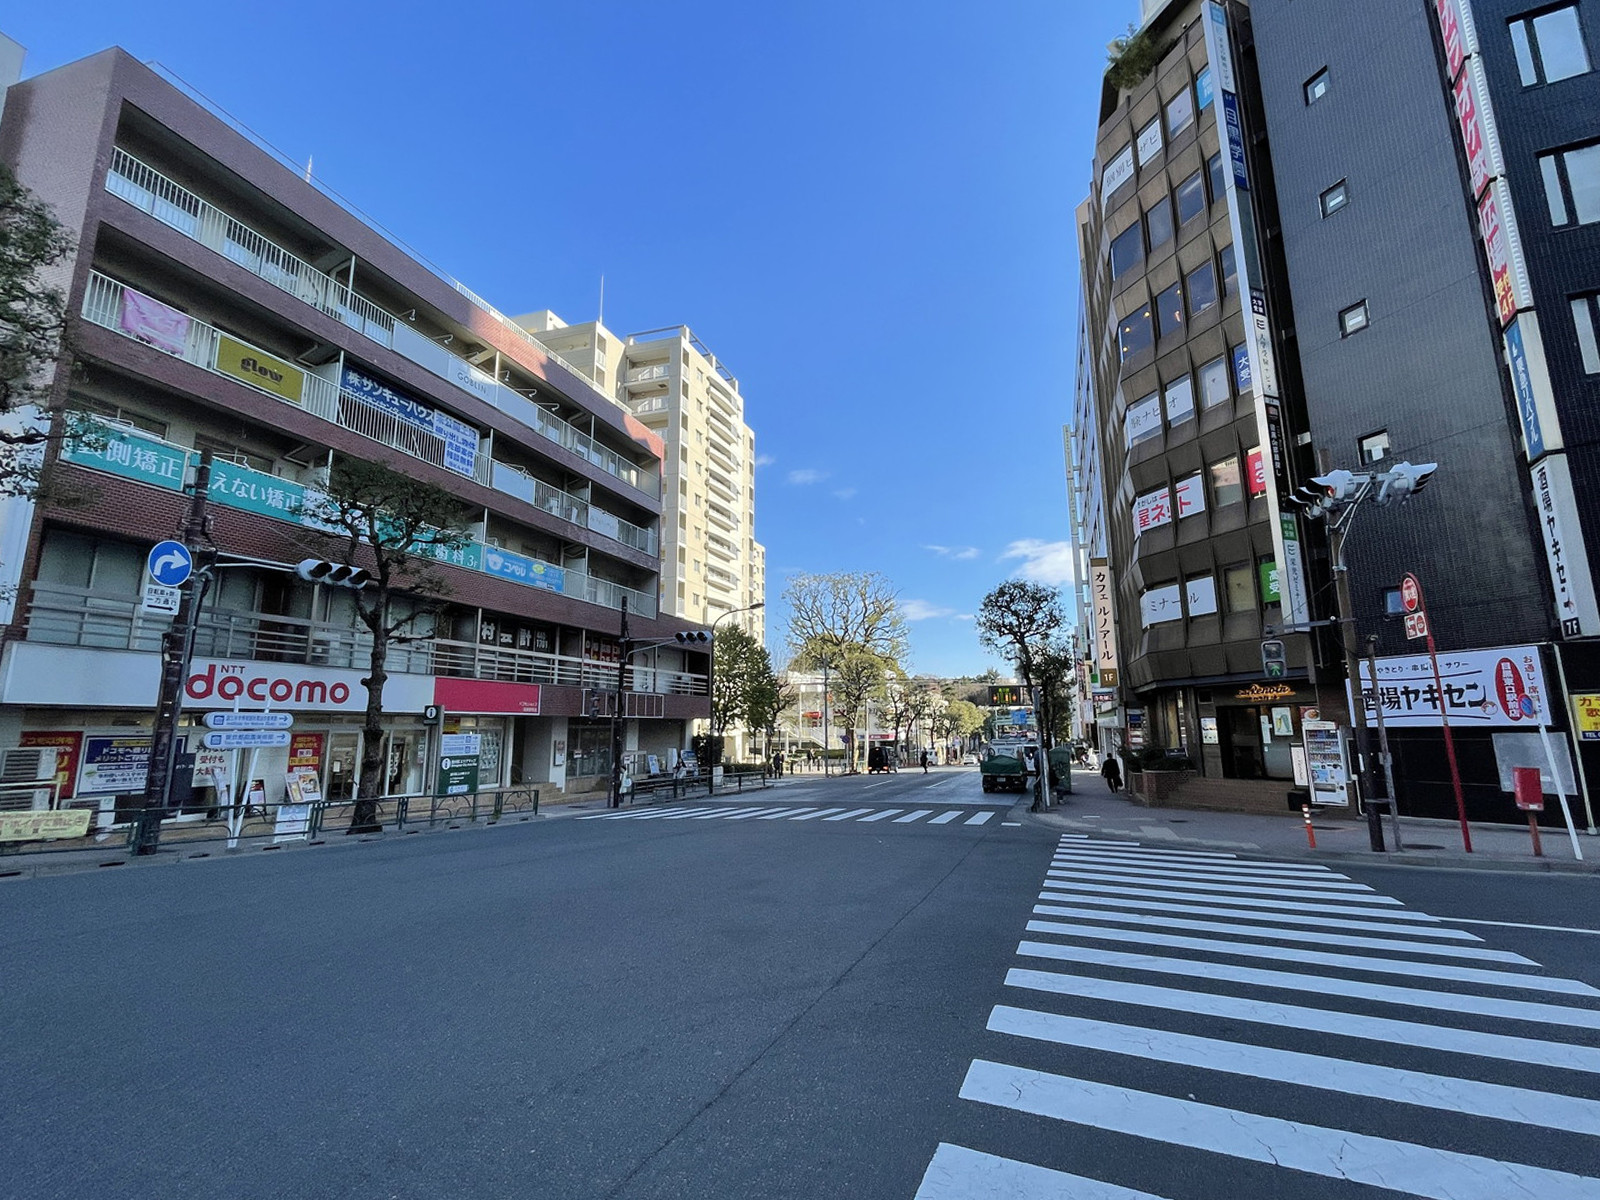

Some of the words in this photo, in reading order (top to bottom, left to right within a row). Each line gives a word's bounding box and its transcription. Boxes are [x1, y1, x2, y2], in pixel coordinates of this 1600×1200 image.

[1501, 291, 1515, 315] 4F
[457, 371, 486, 394] GOBLIN
[1094, 572, 1109, 600] カフェ
[1098, 606, 1113, 660] ルノアール
[1566, 619, 1578, 635] 7F
[220, 664, 246, 674] NTT
[1104, 673, 1114, 681] 1F
[185, 664, 350, 704] docomo
